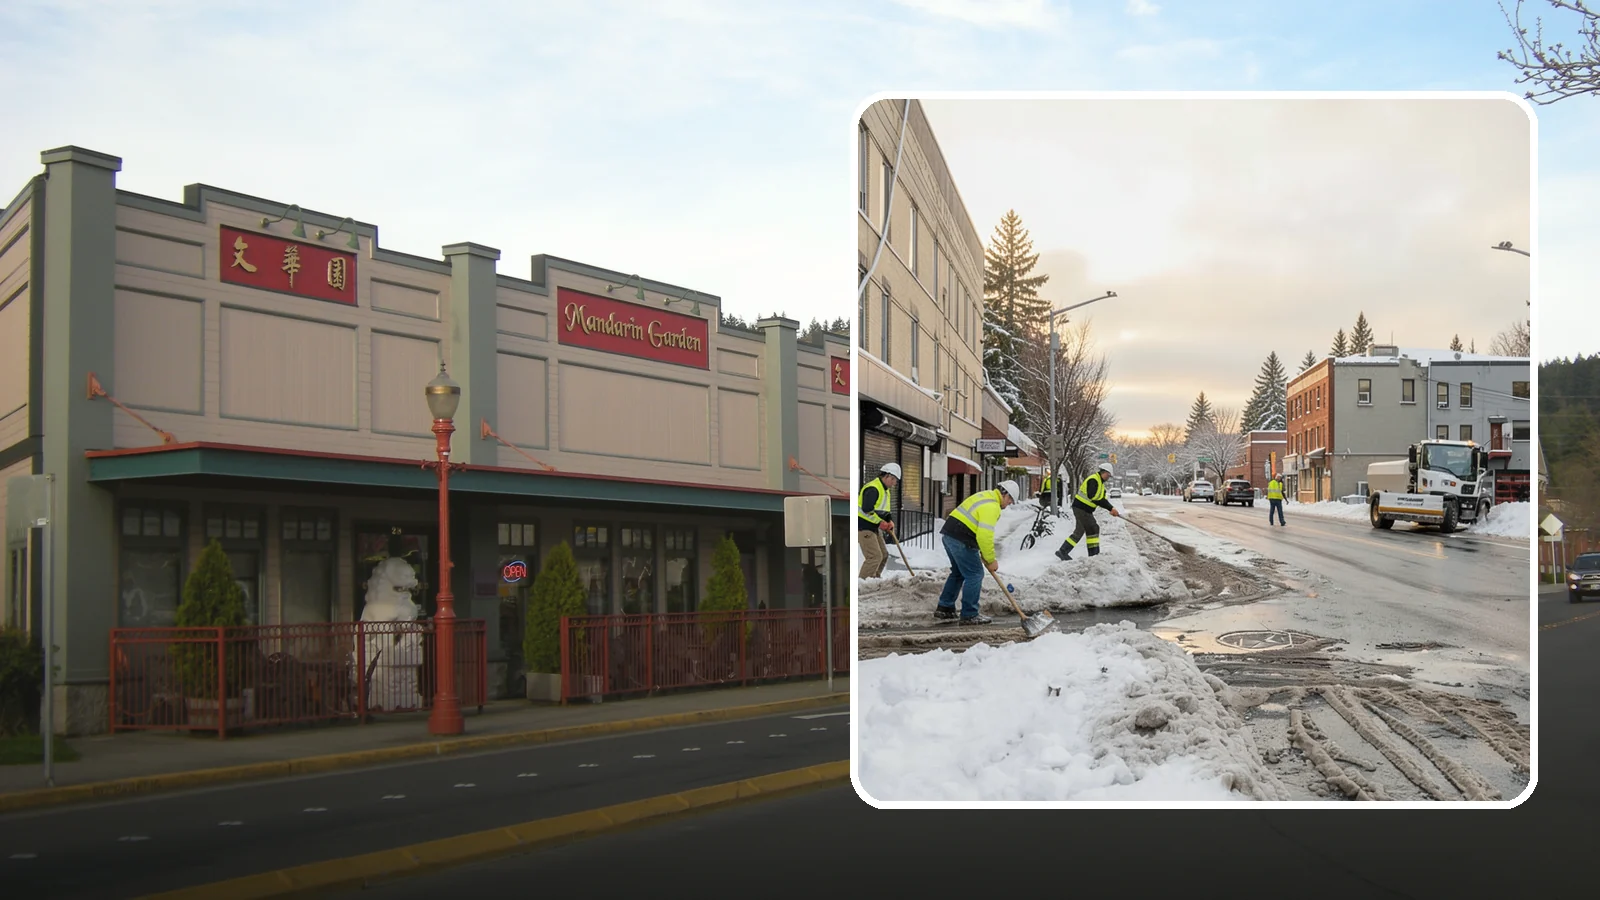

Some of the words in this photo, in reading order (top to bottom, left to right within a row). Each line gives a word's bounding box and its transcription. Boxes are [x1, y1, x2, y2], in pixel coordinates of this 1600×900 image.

[230, 235, 346, 291] 文華園
[564, 302, 645, 341] Mandarin
[647, 320, 702, 352] Garden
[834, 362, 847, 386] 文
[503, 565, 527, 578] OPEN
